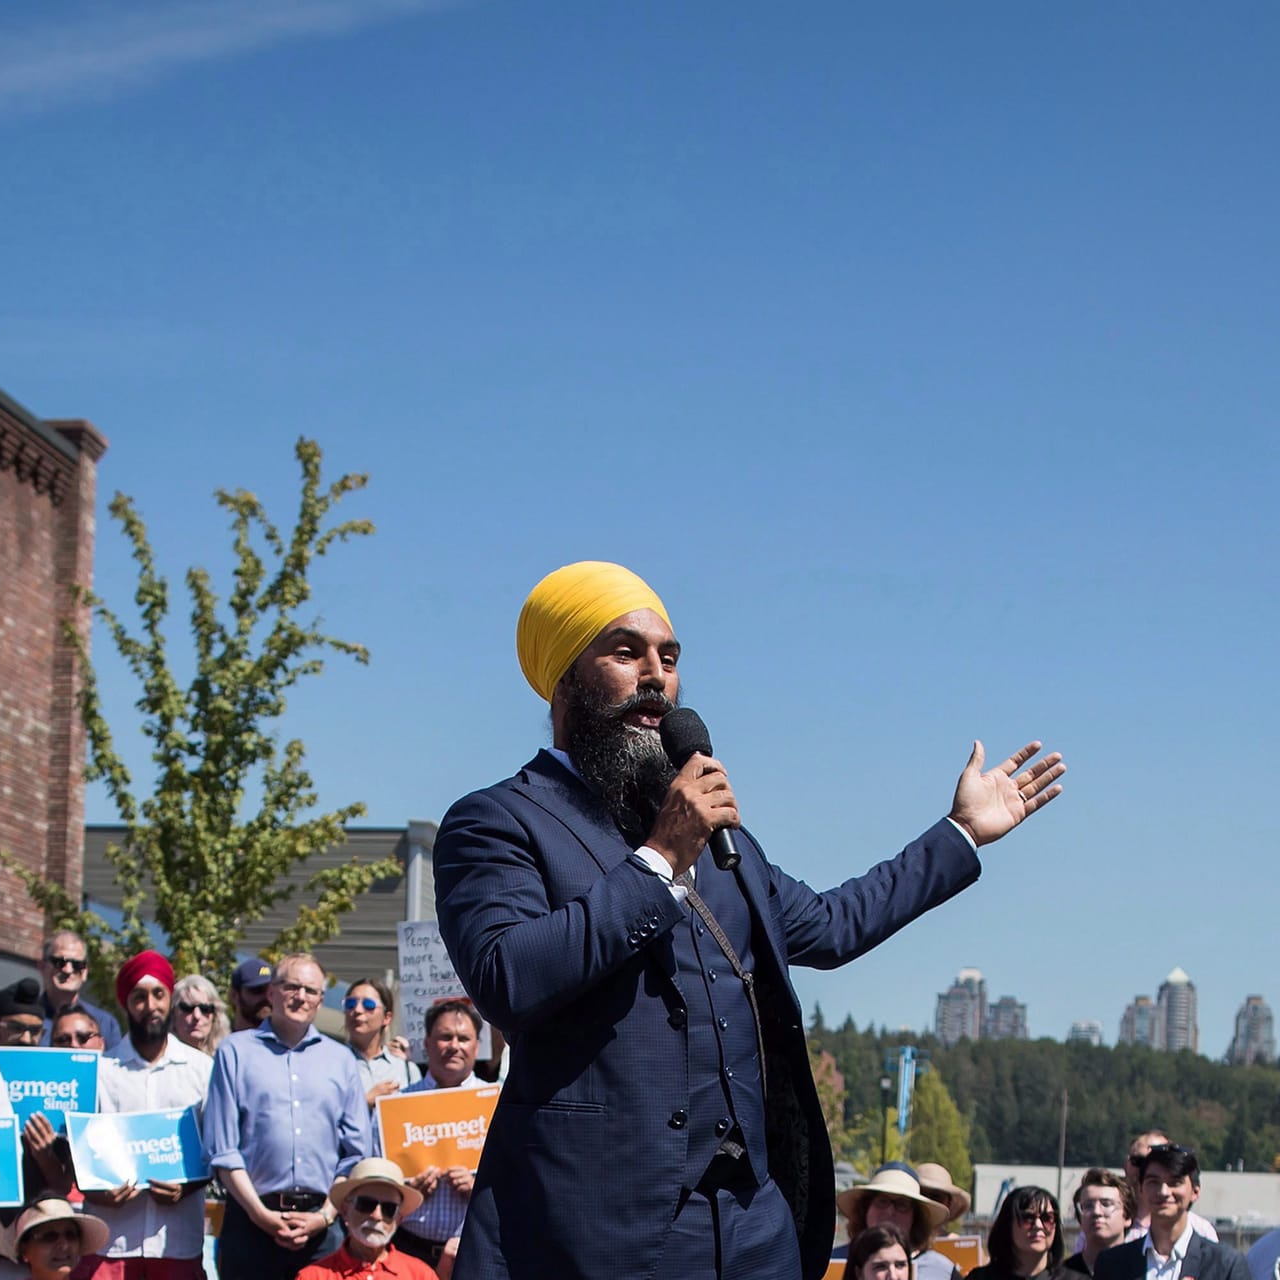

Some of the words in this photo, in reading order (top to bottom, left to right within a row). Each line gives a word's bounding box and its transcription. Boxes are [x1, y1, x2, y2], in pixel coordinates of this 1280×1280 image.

[3, 1078, 79, 1102] agmeet
[43, 1097, 78, 1113] Singh
[402, 1114, 486, 1148] Jagmeet
[125, 1133, 182, 1153] meet
